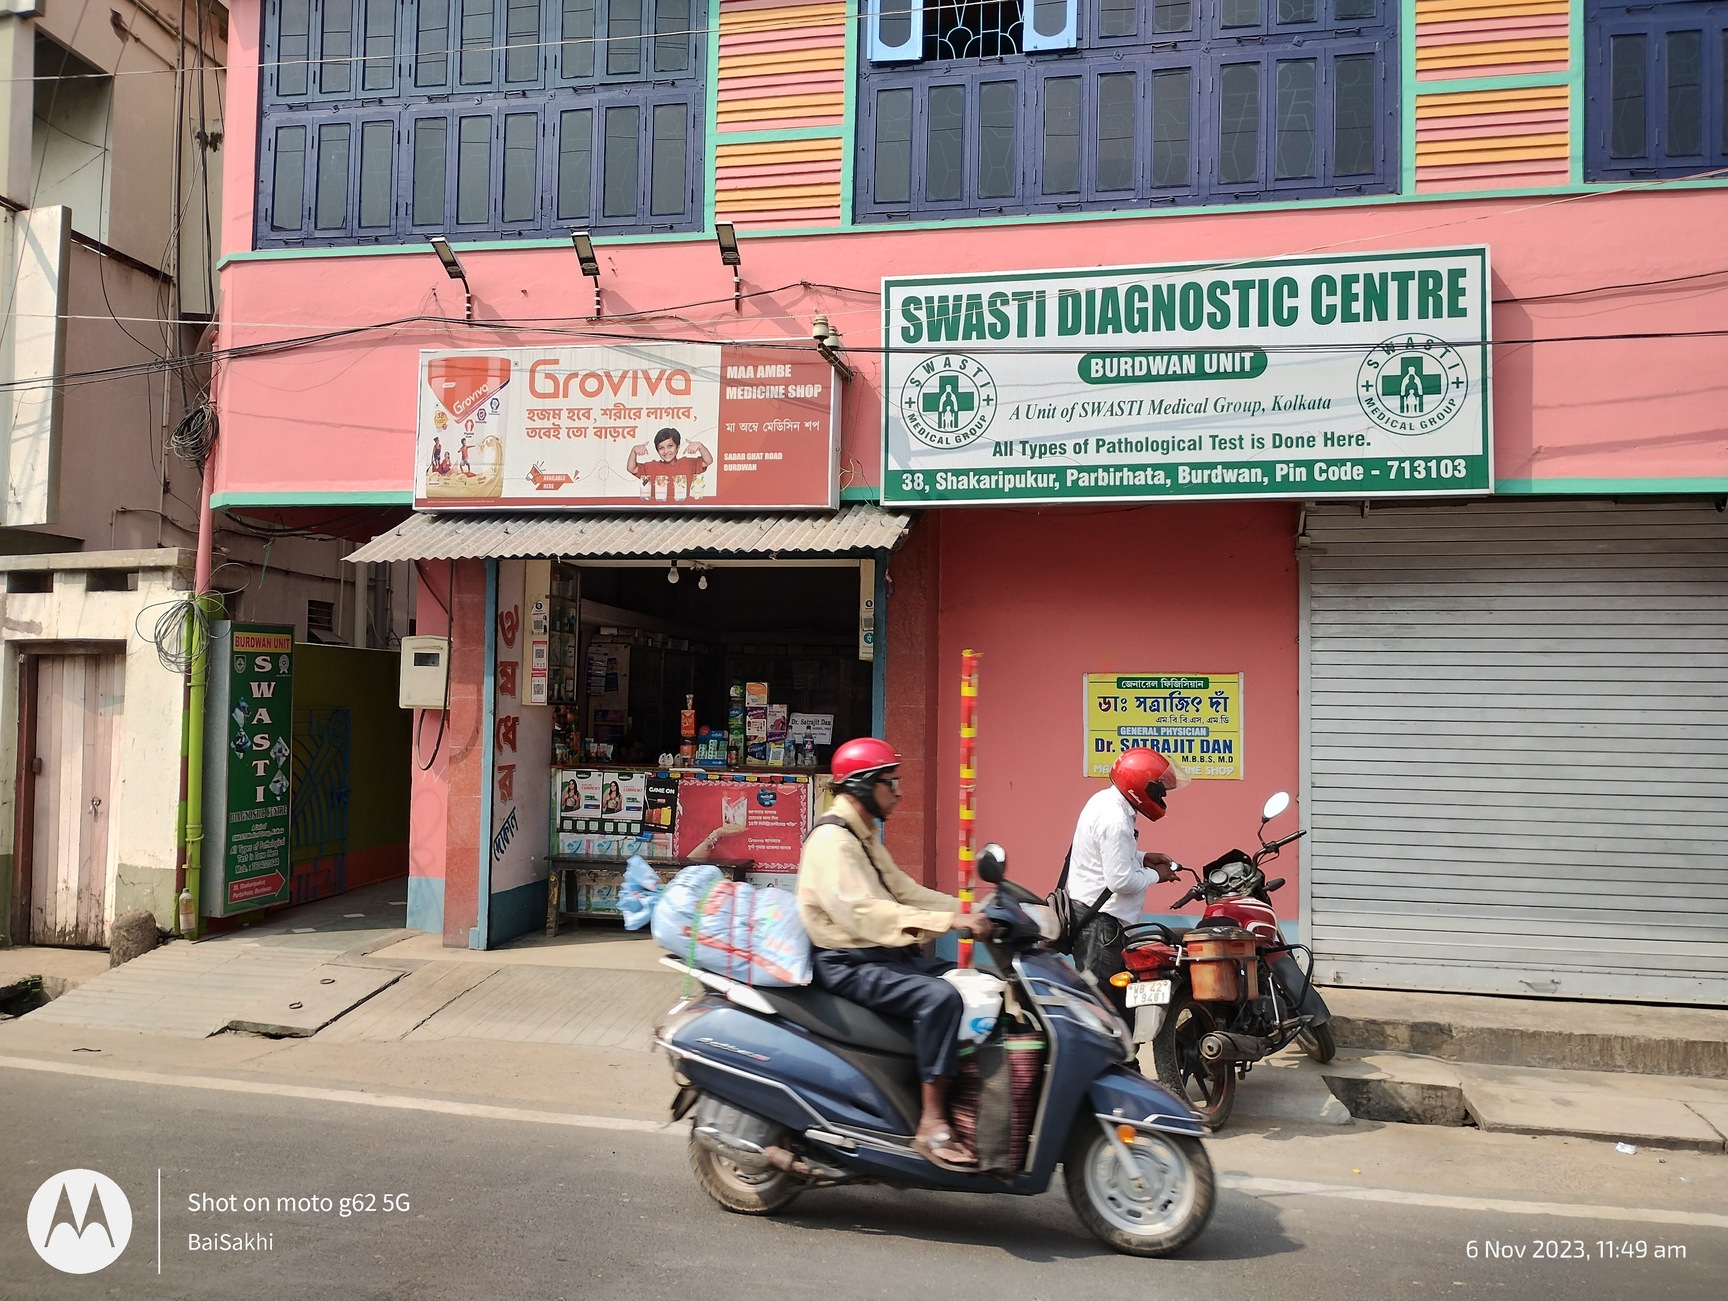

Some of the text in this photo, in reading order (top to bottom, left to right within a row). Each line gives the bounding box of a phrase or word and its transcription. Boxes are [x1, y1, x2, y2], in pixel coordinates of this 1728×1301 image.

[901, 268, 1467, 344] SWASTI DIAGNOSTIC CENTRE
[1367, 337, 1460, 370] SWASTI
[727, 364, 792, 379] MAA AMBE
[909, 357, 991, 388] SWASTI
[1090, 352, 1254, 378] BURDWAN UNIT
[529, 358, 692, 399] Groviva
[453, 384, 489, 415] Groviva
[726, 384, 822, 400] MEDICINE SHOP
[526, 408, 563, 422] হজম
[600, 402, 643, 421] শরীরে
[1009, 395, 1331, 423] A Unit of SWASTI Medical Group, Kolkata
[1365, 397, 1456, 430] MEDICAL GROUP
[525, 422, 638, 443] তবেই তো বাড়বে
[726, 422, 736, 432] মা
[762, 418, 800, 432] মেডিসিন
[804, 420, 820, 431] শপ
[908, 413, 987, 444] MEDICAL GROUP
[992, 431, 1371, 460] All Types of Pathological Test is Done Here.
[723, 452, 783, 461] SADAR GHAT ROAD
[723, 463, 757, 472] BURDWAN
[901, 473, 930, 493] 38,
[935, 471, 1060, 493] Shakaripukur,
[1066, 466, 1172, 488] Parbirhata,
[1178, 464, 1268, 486] Burdwan,
[1275, 463, 1307, 482] Pin
[1313, 462, 1364, 481] Code
[1387, 459, 1467, 480] 713103
[234, 634, 291, 649] BURDWAN UNIT
[1121, 679, 1158, 689] জেনারেল
[1120, 727, 1207, 736] GENERAL PHYSICIAN
[1094, 738, 1233, 754] Dr. SATRAJIT DAN
[1094, 765, 1111, 774] MA
[1206, 765, 1235, 776] SHOP
[1134, 983, 1162, 994] WB 42
[1141, 992, 1165, 1003] 9481
